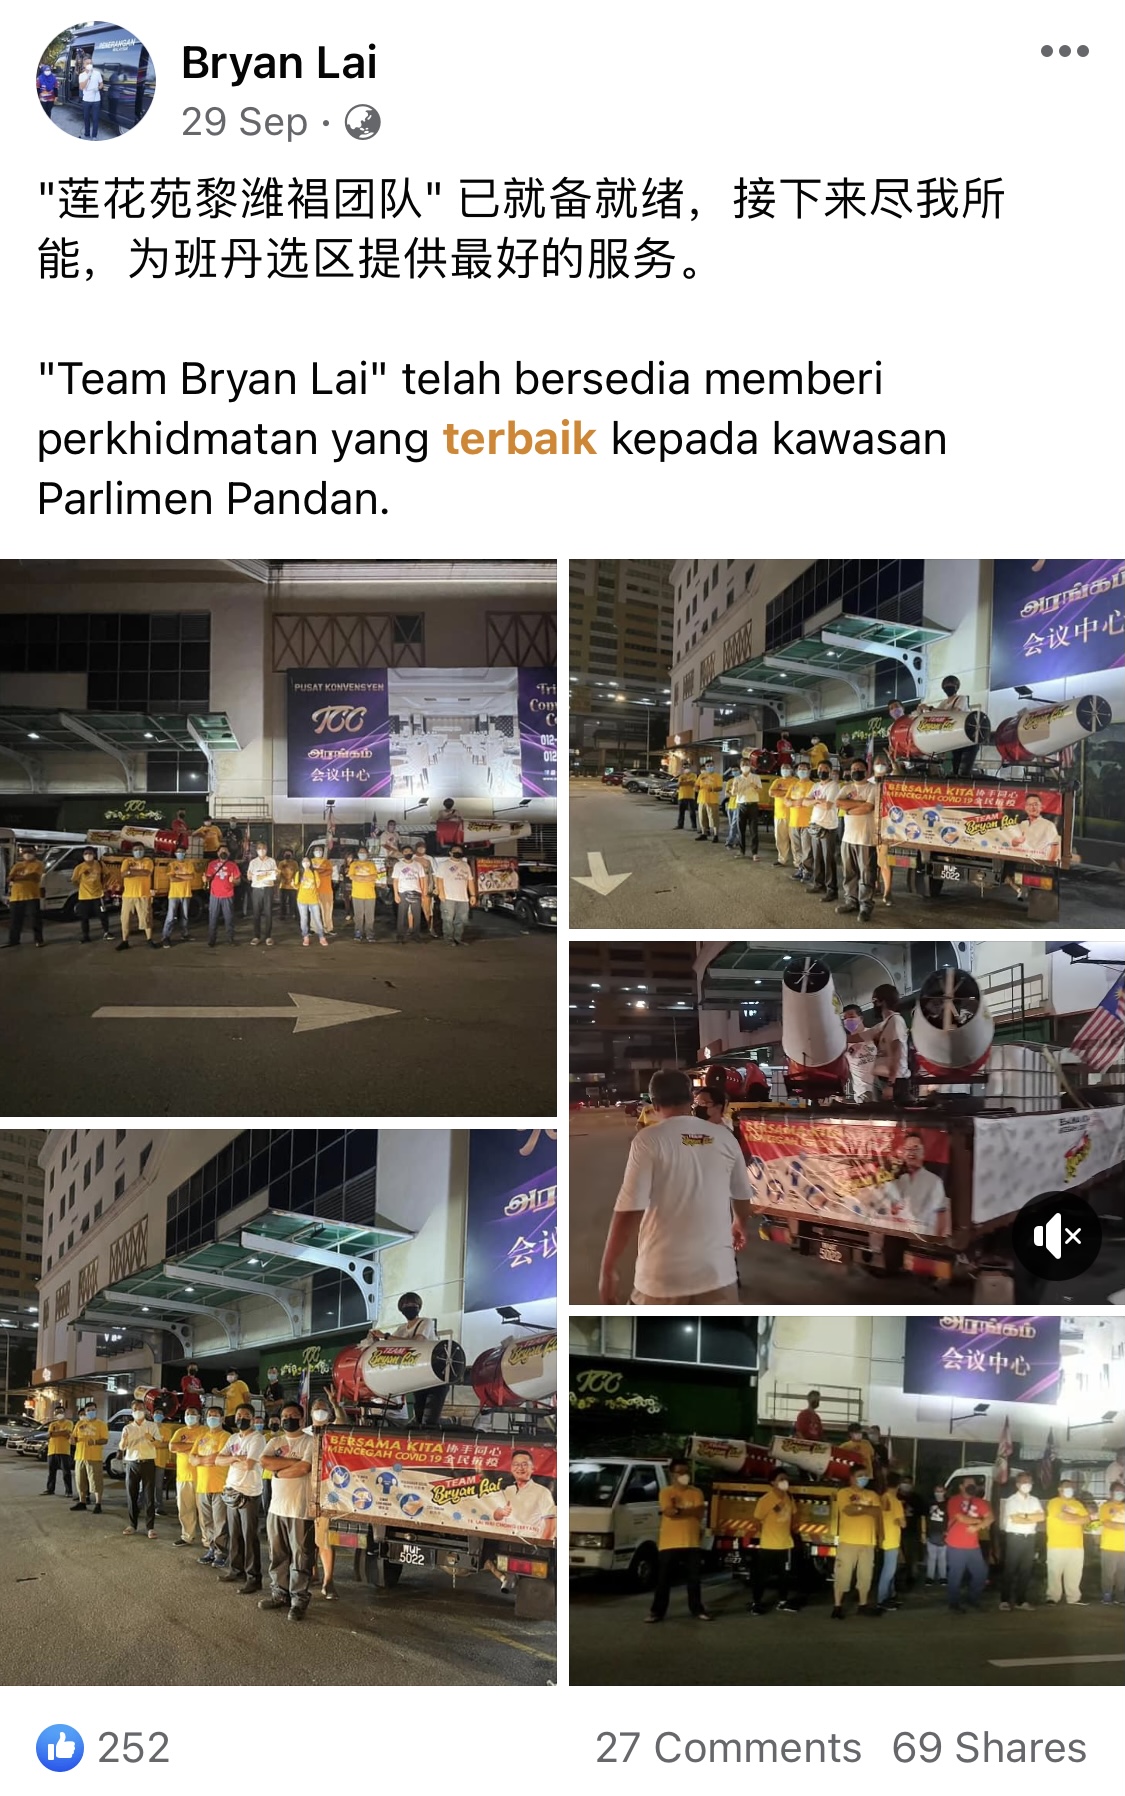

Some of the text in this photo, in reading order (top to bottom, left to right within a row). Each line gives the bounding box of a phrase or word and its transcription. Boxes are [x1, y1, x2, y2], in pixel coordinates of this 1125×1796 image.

[1022, 609, 1125, 657] 会议中心
[294, 682, 384, 692] PUSAT KONVENSYEN
[311, 767, 371, 782] 会议中心
[886, 790, 974, 805] MENCEGAH COVID 19
[887, 783, 974, 797] BERSAMA KITA
[965, 820, 998, 836] Bryan
[1001, 814, 1019, 829] Lai
[976, 813, 999, 823] TEAM
[941, 871, 960, 881] 5022
[383, 1347, 406, 1355] TEAM
[368, 1350, 400, 1369] Bryan
[942, 1346, 1031, 1377] 会议中心
[330, 1435, 444, 1453] BERSAMA KITA
[327, 1445, 443, 1463] MENCEGAH COVID 19
[446, 1477, 476, 1488] TEAM
[432, 1484, 476, 1505] Bryan
[479, 1477, 503, 1499] Lai
[400, 1553, 425, 1566] 5022
